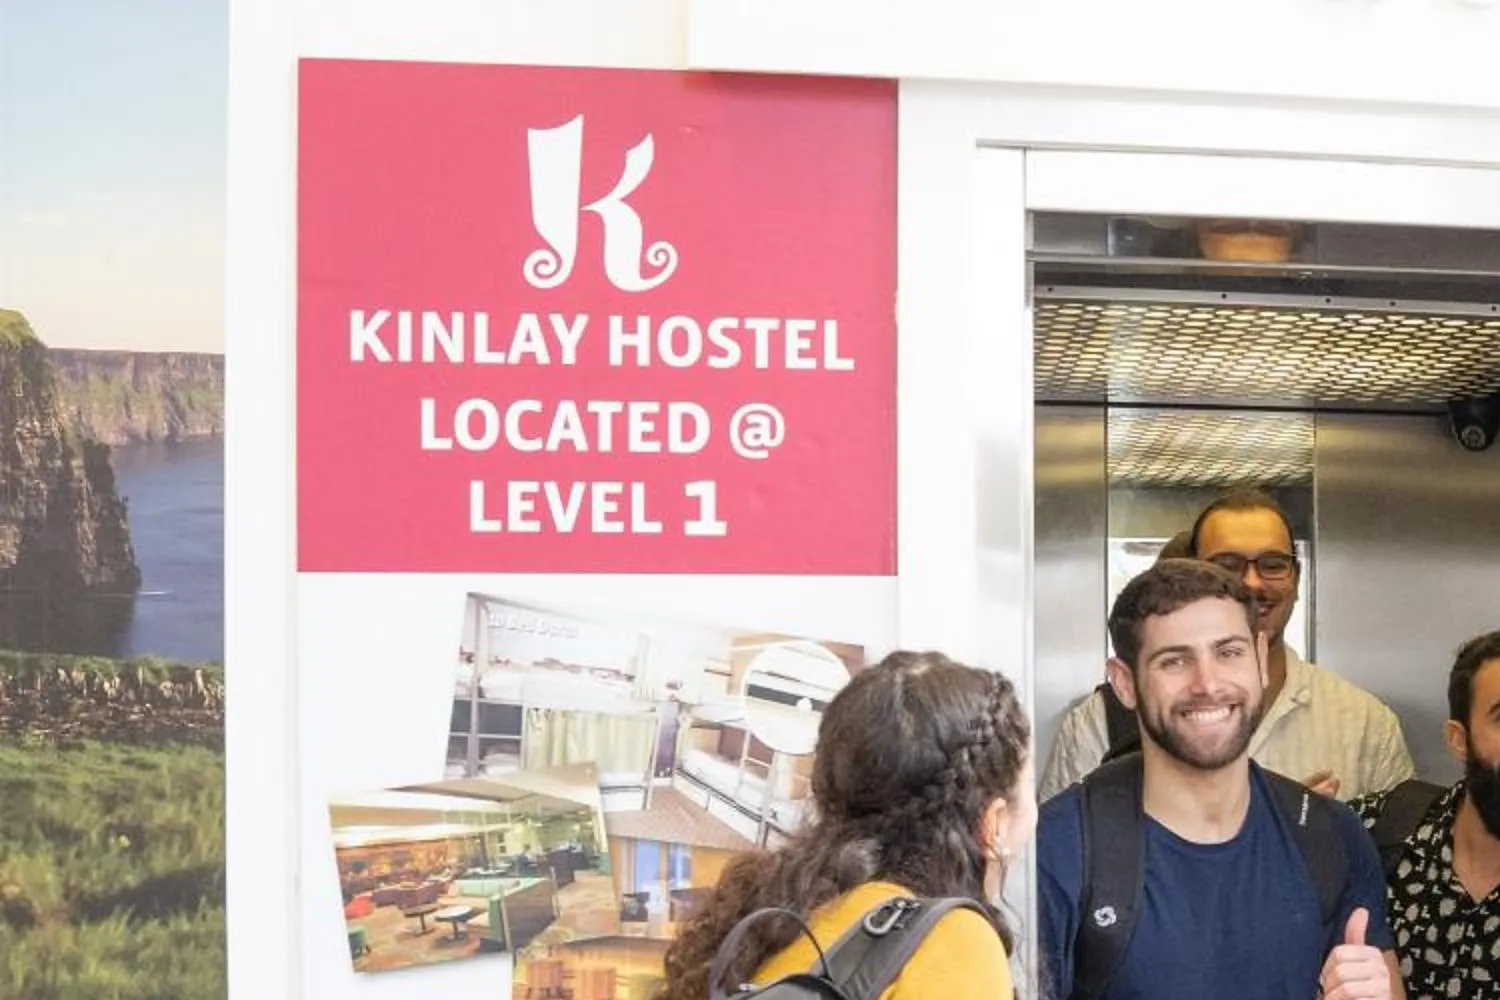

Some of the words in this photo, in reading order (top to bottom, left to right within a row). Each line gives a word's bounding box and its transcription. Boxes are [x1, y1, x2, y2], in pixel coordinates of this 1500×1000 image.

[349, 309, 590, 365] KINLAY
[608, 314, 856, 371] HOSTEL
[420, 397, 711, 455] LOCATED
[729, 403, 786, 459] @
[469, 480, 663, 534] LEVEL
[684, 480, 728, 537] 1
